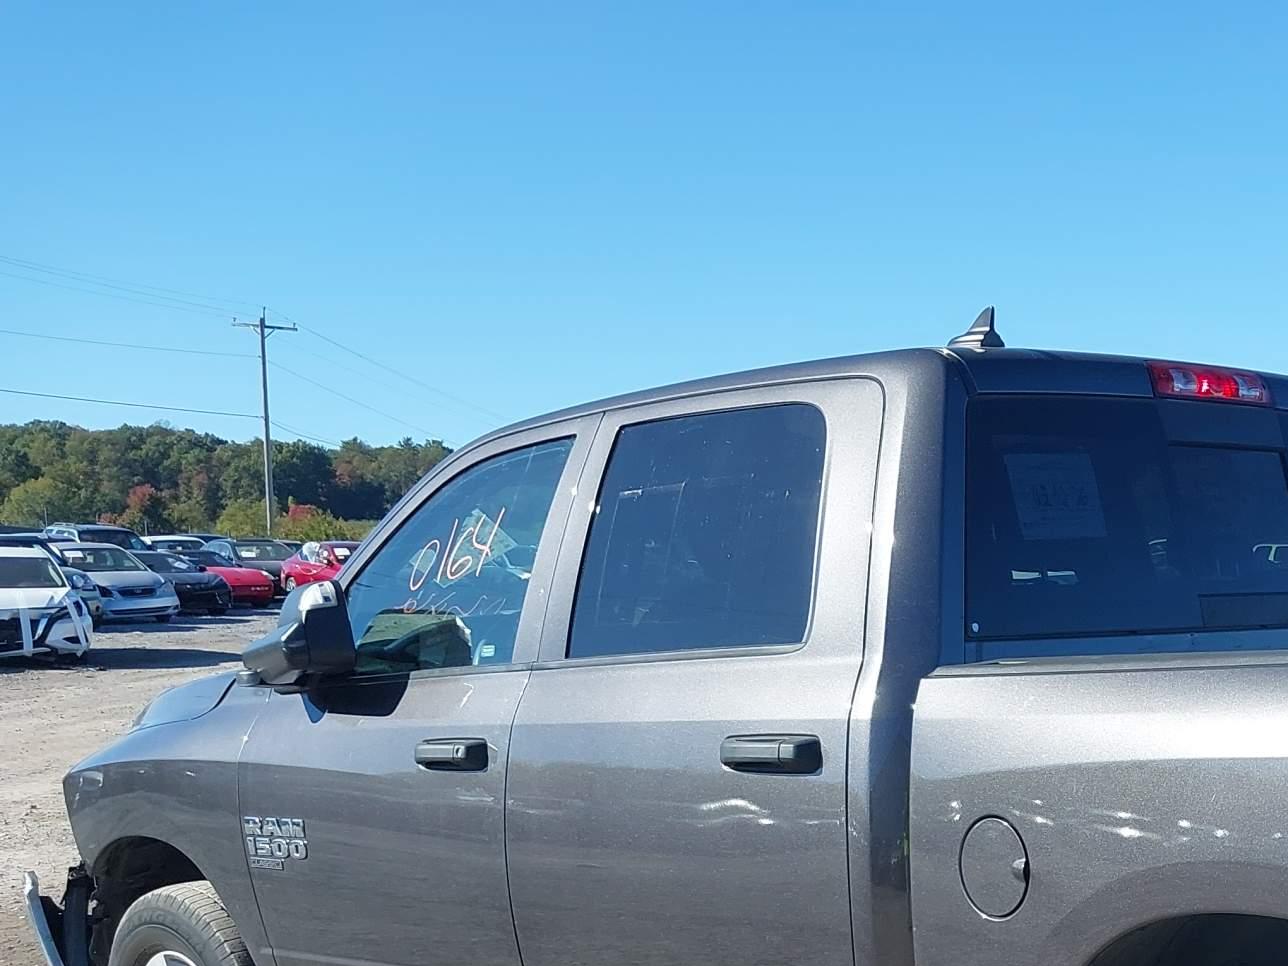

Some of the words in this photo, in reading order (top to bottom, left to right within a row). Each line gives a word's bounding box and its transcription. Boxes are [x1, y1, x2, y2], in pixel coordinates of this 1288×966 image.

[409, 507, 506, 591] 0164
[243, 816, 305, 838] RAM
[246, 836, 308, 861] 1500
